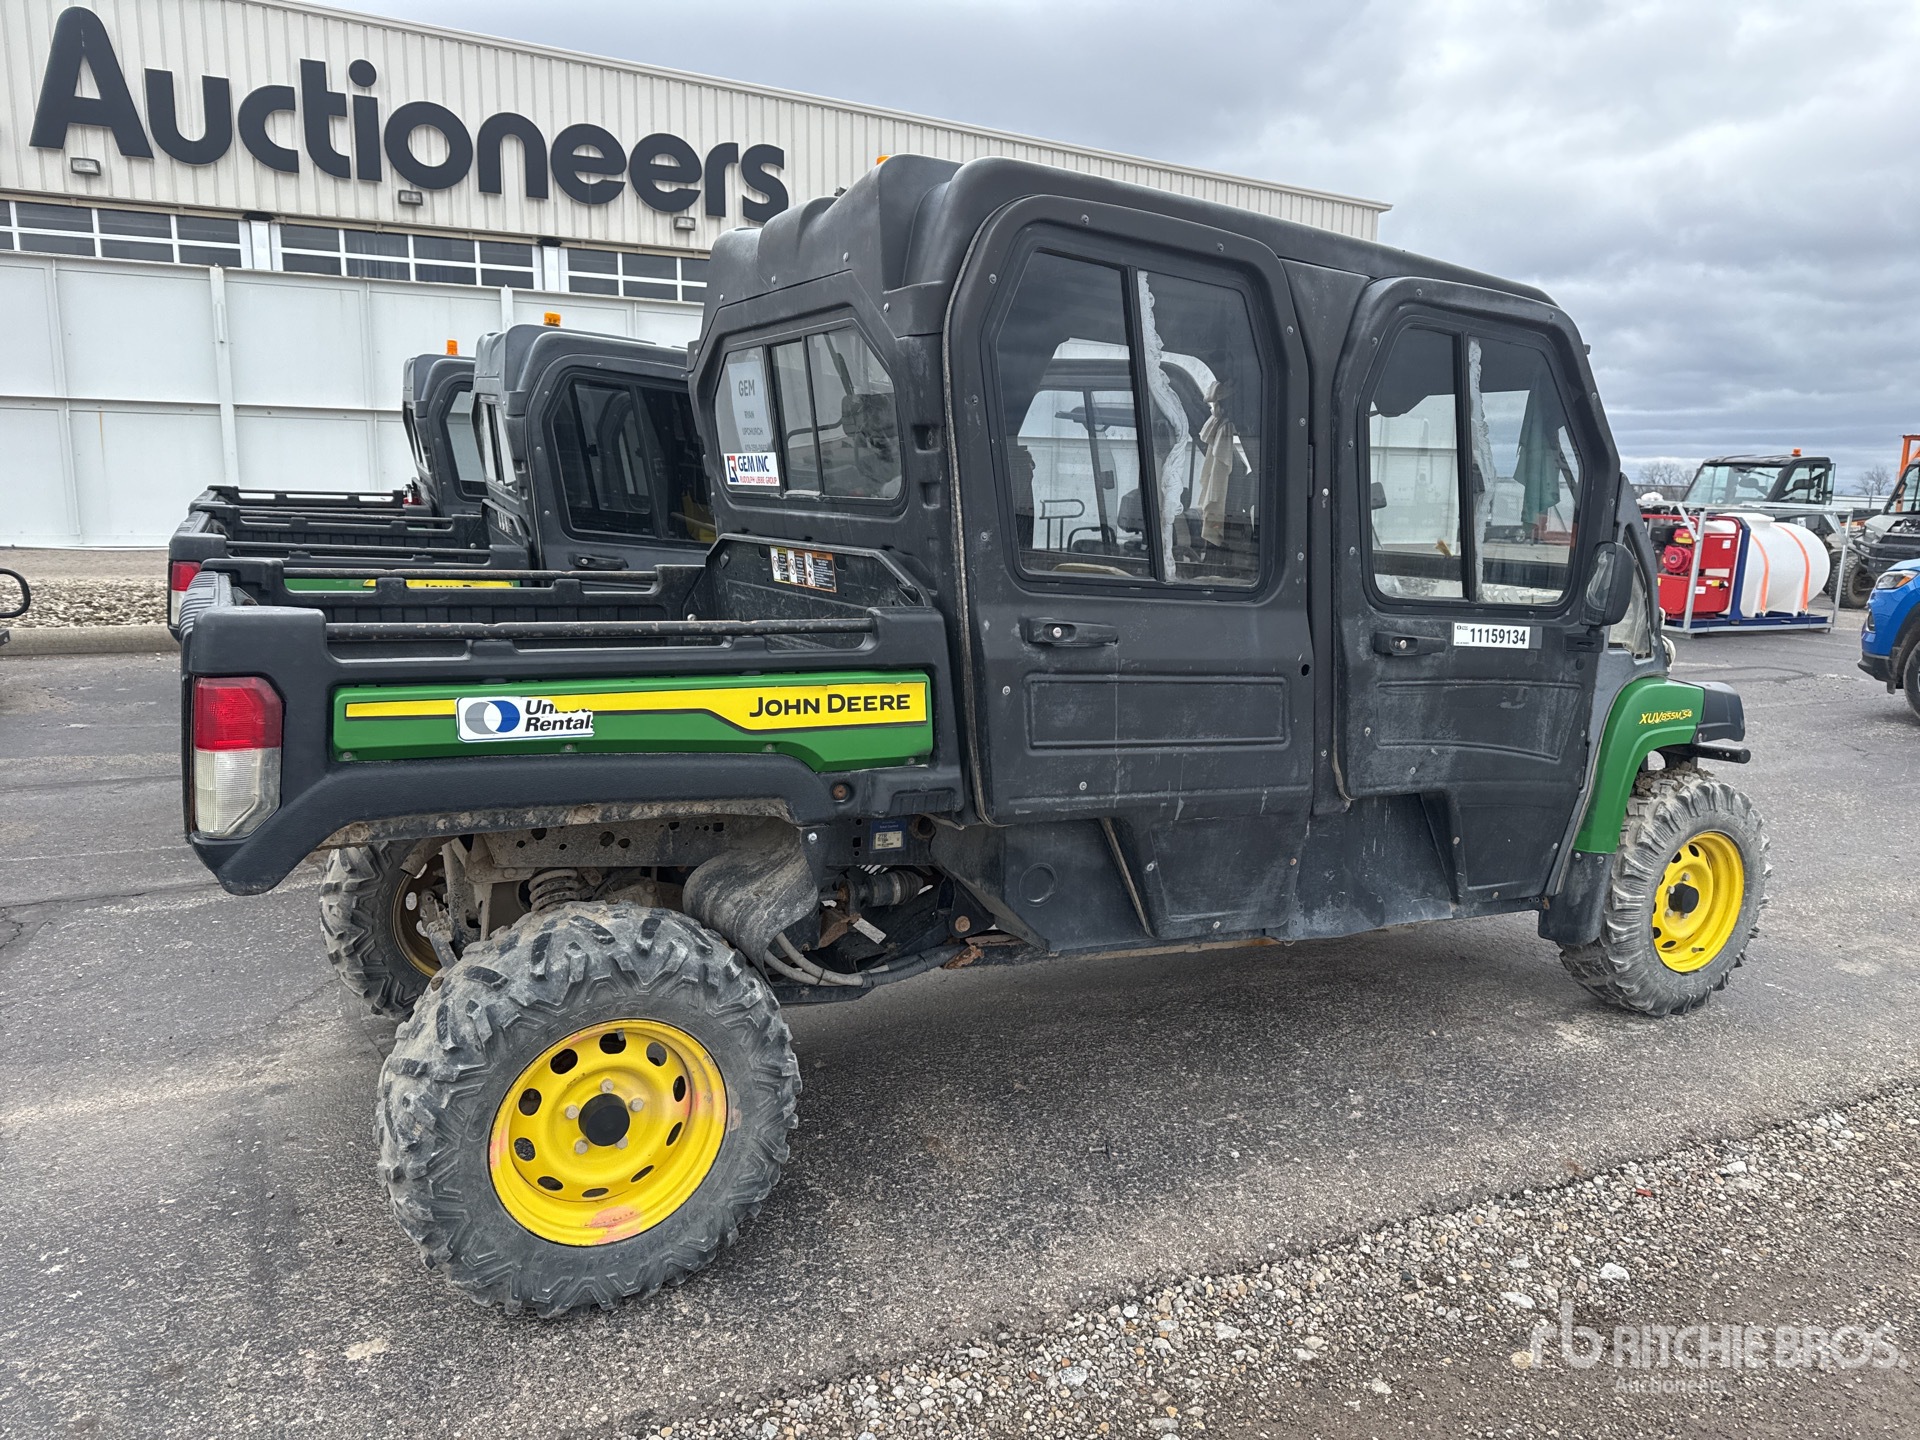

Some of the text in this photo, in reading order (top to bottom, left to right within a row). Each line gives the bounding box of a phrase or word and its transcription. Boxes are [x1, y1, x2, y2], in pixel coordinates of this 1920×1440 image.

[28, 6, 789, 222] Auctioneers
[738, 380, 755, 397] GEM
[738, 455, 769, 472] GEM INC
[1470, 628, 1526, 645] 11159134
[749, 693, 910, 717] JOHN DEERE
[525, 715, 593, 732] Rental
